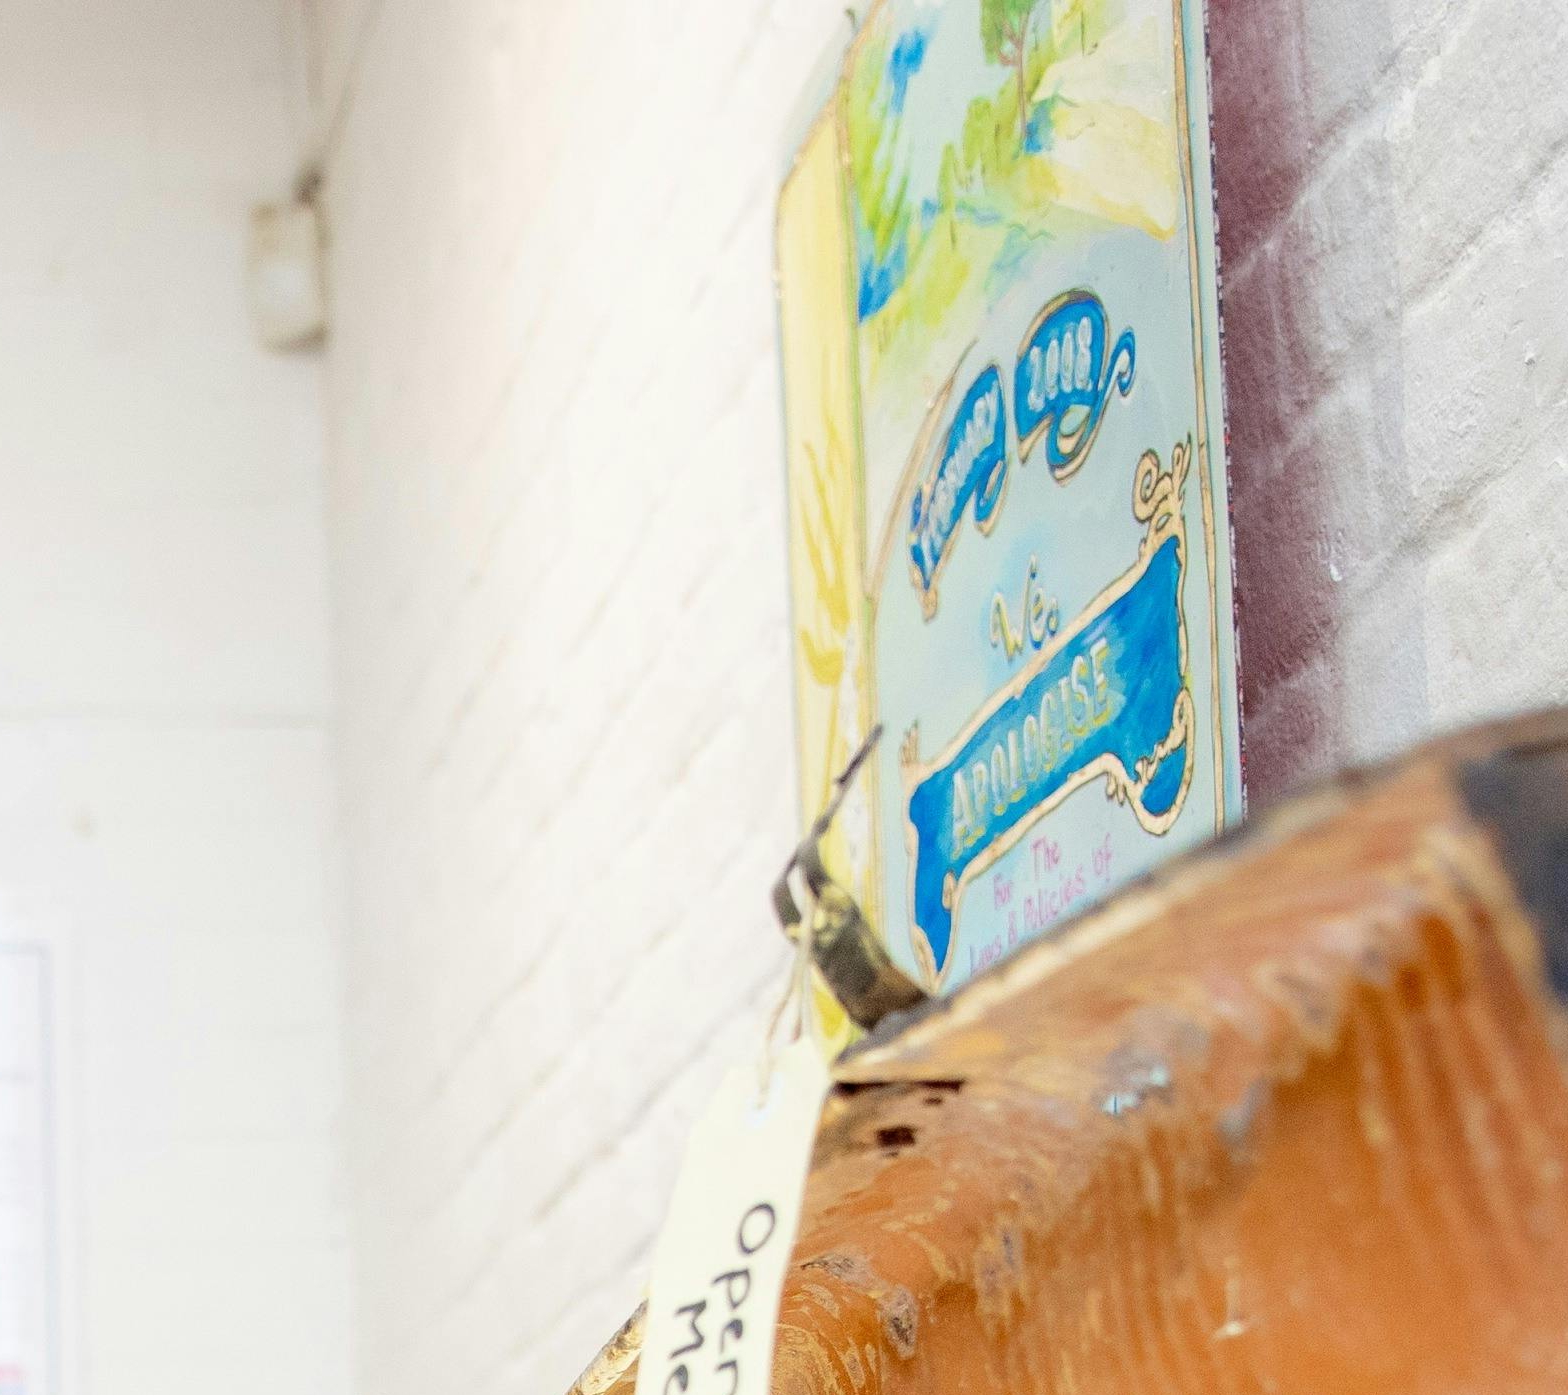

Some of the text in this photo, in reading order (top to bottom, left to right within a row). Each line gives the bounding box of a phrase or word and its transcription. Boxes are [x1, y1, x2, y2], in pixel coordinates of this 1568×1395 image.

[1027, 315, 1093, 412] 2008
[950, 637, 1113, 859] APOLOGISE
[1031, 835, 1061, 881] The
[1093, 832, 1112, 883] of
